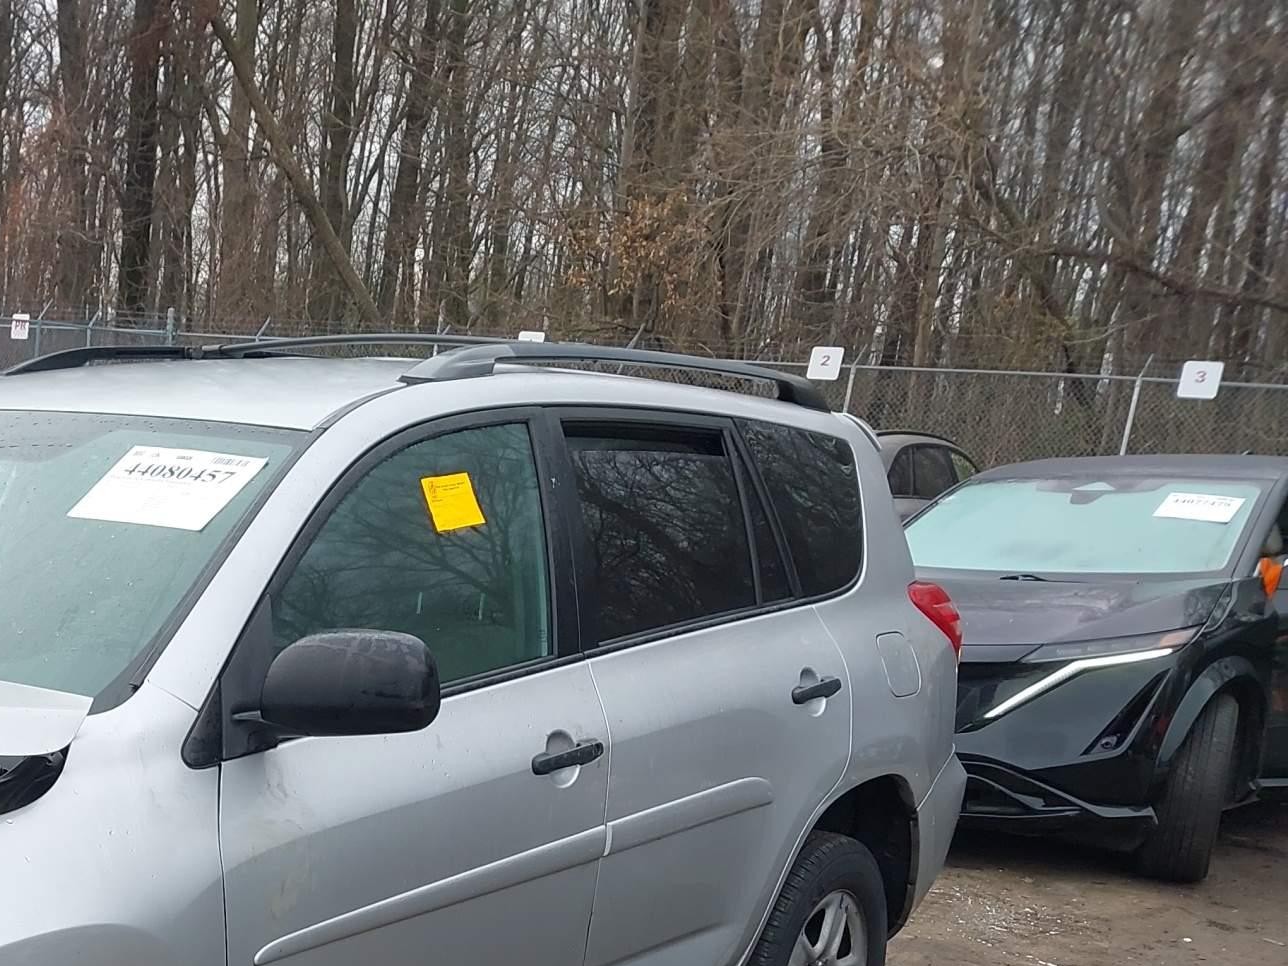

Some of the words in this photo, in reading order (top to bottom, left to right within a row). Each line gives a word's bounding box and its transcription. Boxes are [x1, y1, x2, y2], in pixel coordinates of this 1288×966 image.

[820, 354, 831, 367] 2
[1194, 370, 1208, 384] 3
[124, 461, 238, 485] 44080457
